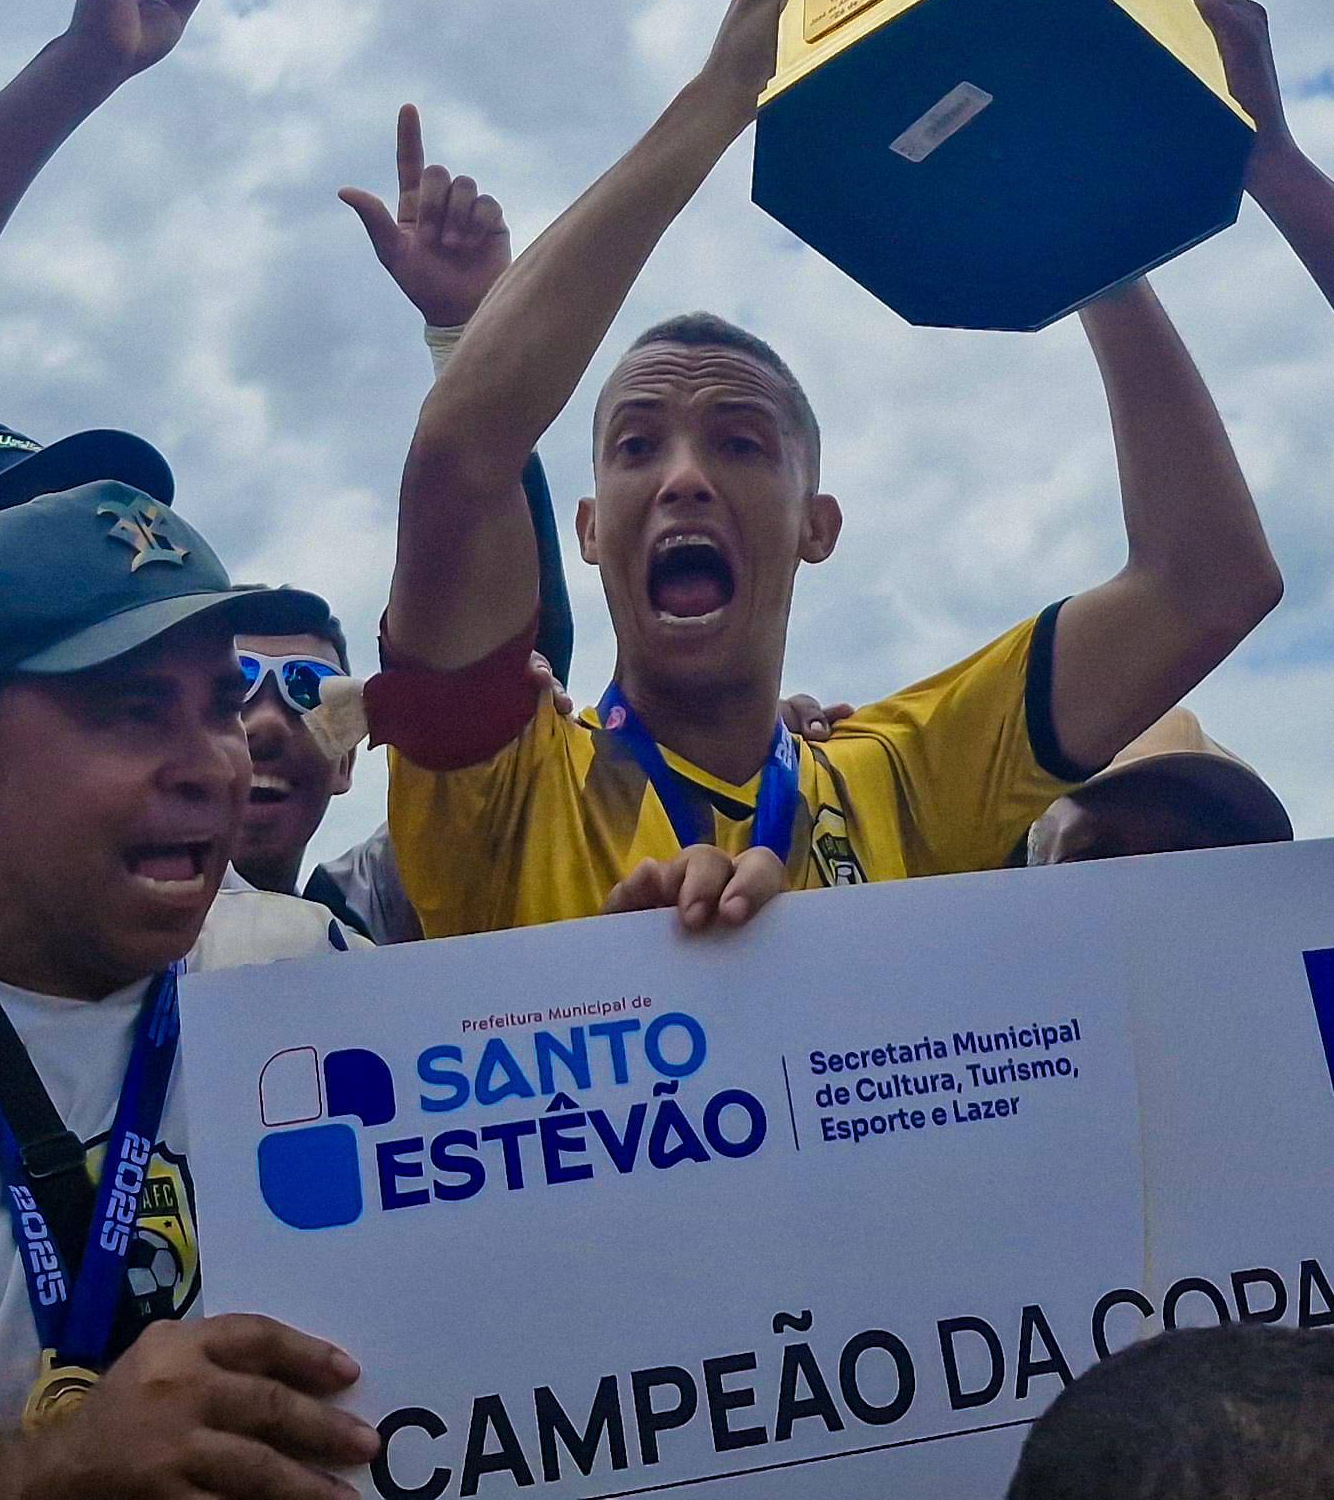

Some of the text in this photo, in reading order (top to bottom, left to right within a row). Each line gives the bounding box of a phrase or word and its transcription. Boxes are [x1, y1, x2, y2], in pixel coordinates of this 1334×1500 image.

[415, 1011, 708, 1113] SANTO
[461, 995, 653, 1033] Prefeitura Municipal de
[808, 1018, 1081, 1075] Secretaria Municipal
[815, 1055, 1080, 1108] de Cultura, Turismo,
[820, 1096, 1020, 1144] Esporte e Lazer
[100, 1130, 152, 1257] 2025
[374, 1078, 768, 1212] ESTÊVÃO
[8, 1185, 67, 1306] 2025
[369, 1309, 917, 1500] CAMPEÃO
[937, 1304, 1074, 1411] DA
